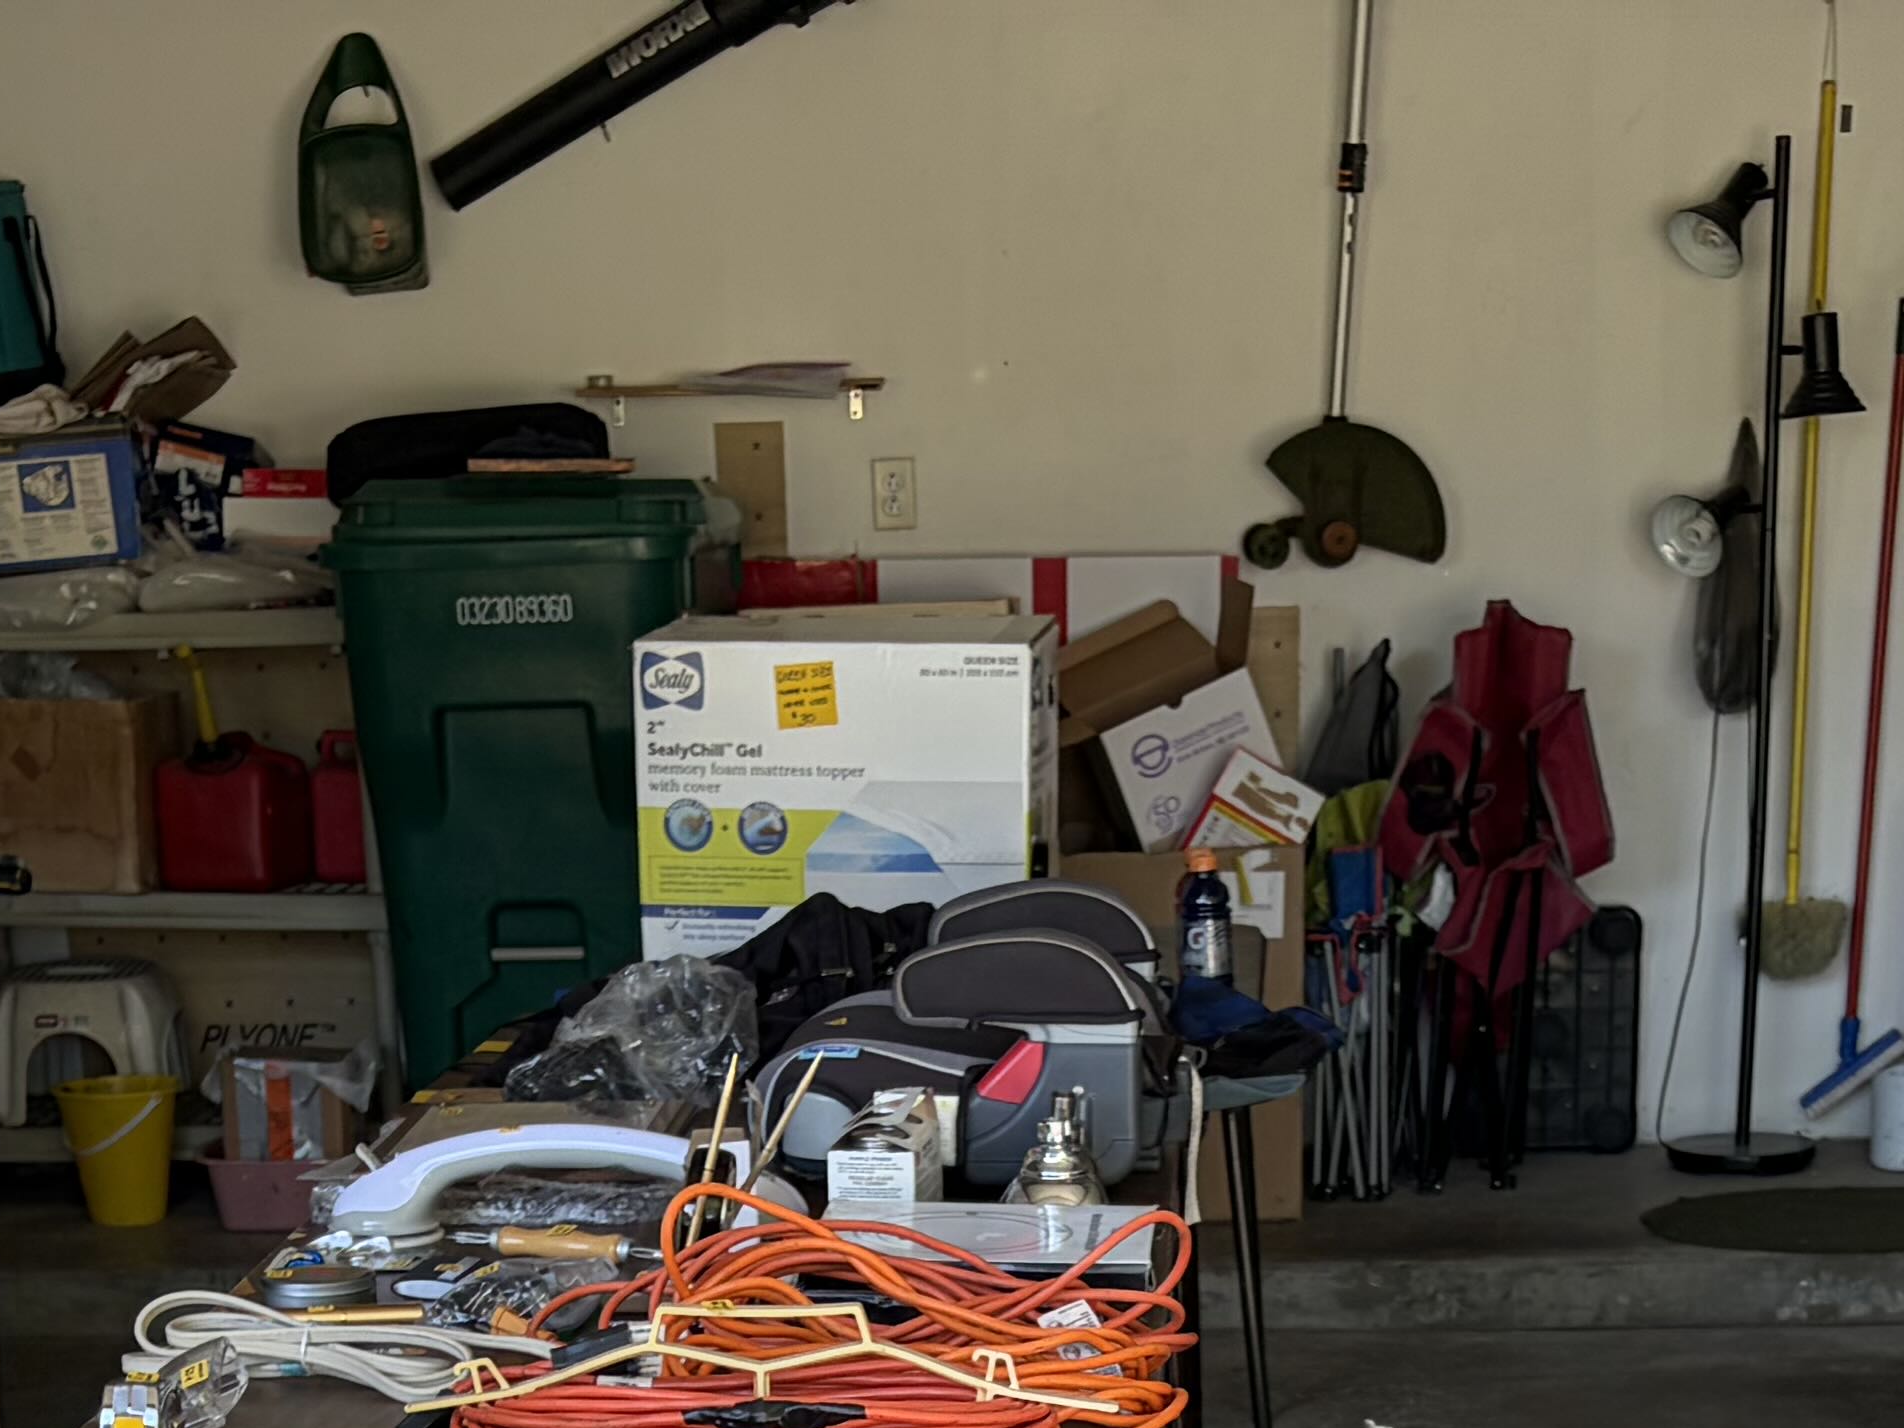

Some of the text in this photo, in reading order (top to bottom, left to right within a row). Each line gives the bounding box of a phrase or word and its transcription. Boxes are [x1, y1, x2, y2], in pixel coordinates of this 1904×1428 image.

[649, 667, 694, 694] Sealy
[736, 744, 763, 758] Gel
[647, 763, 865, 781] memory foam mattress topper
[648, 780, 680, 793] with
